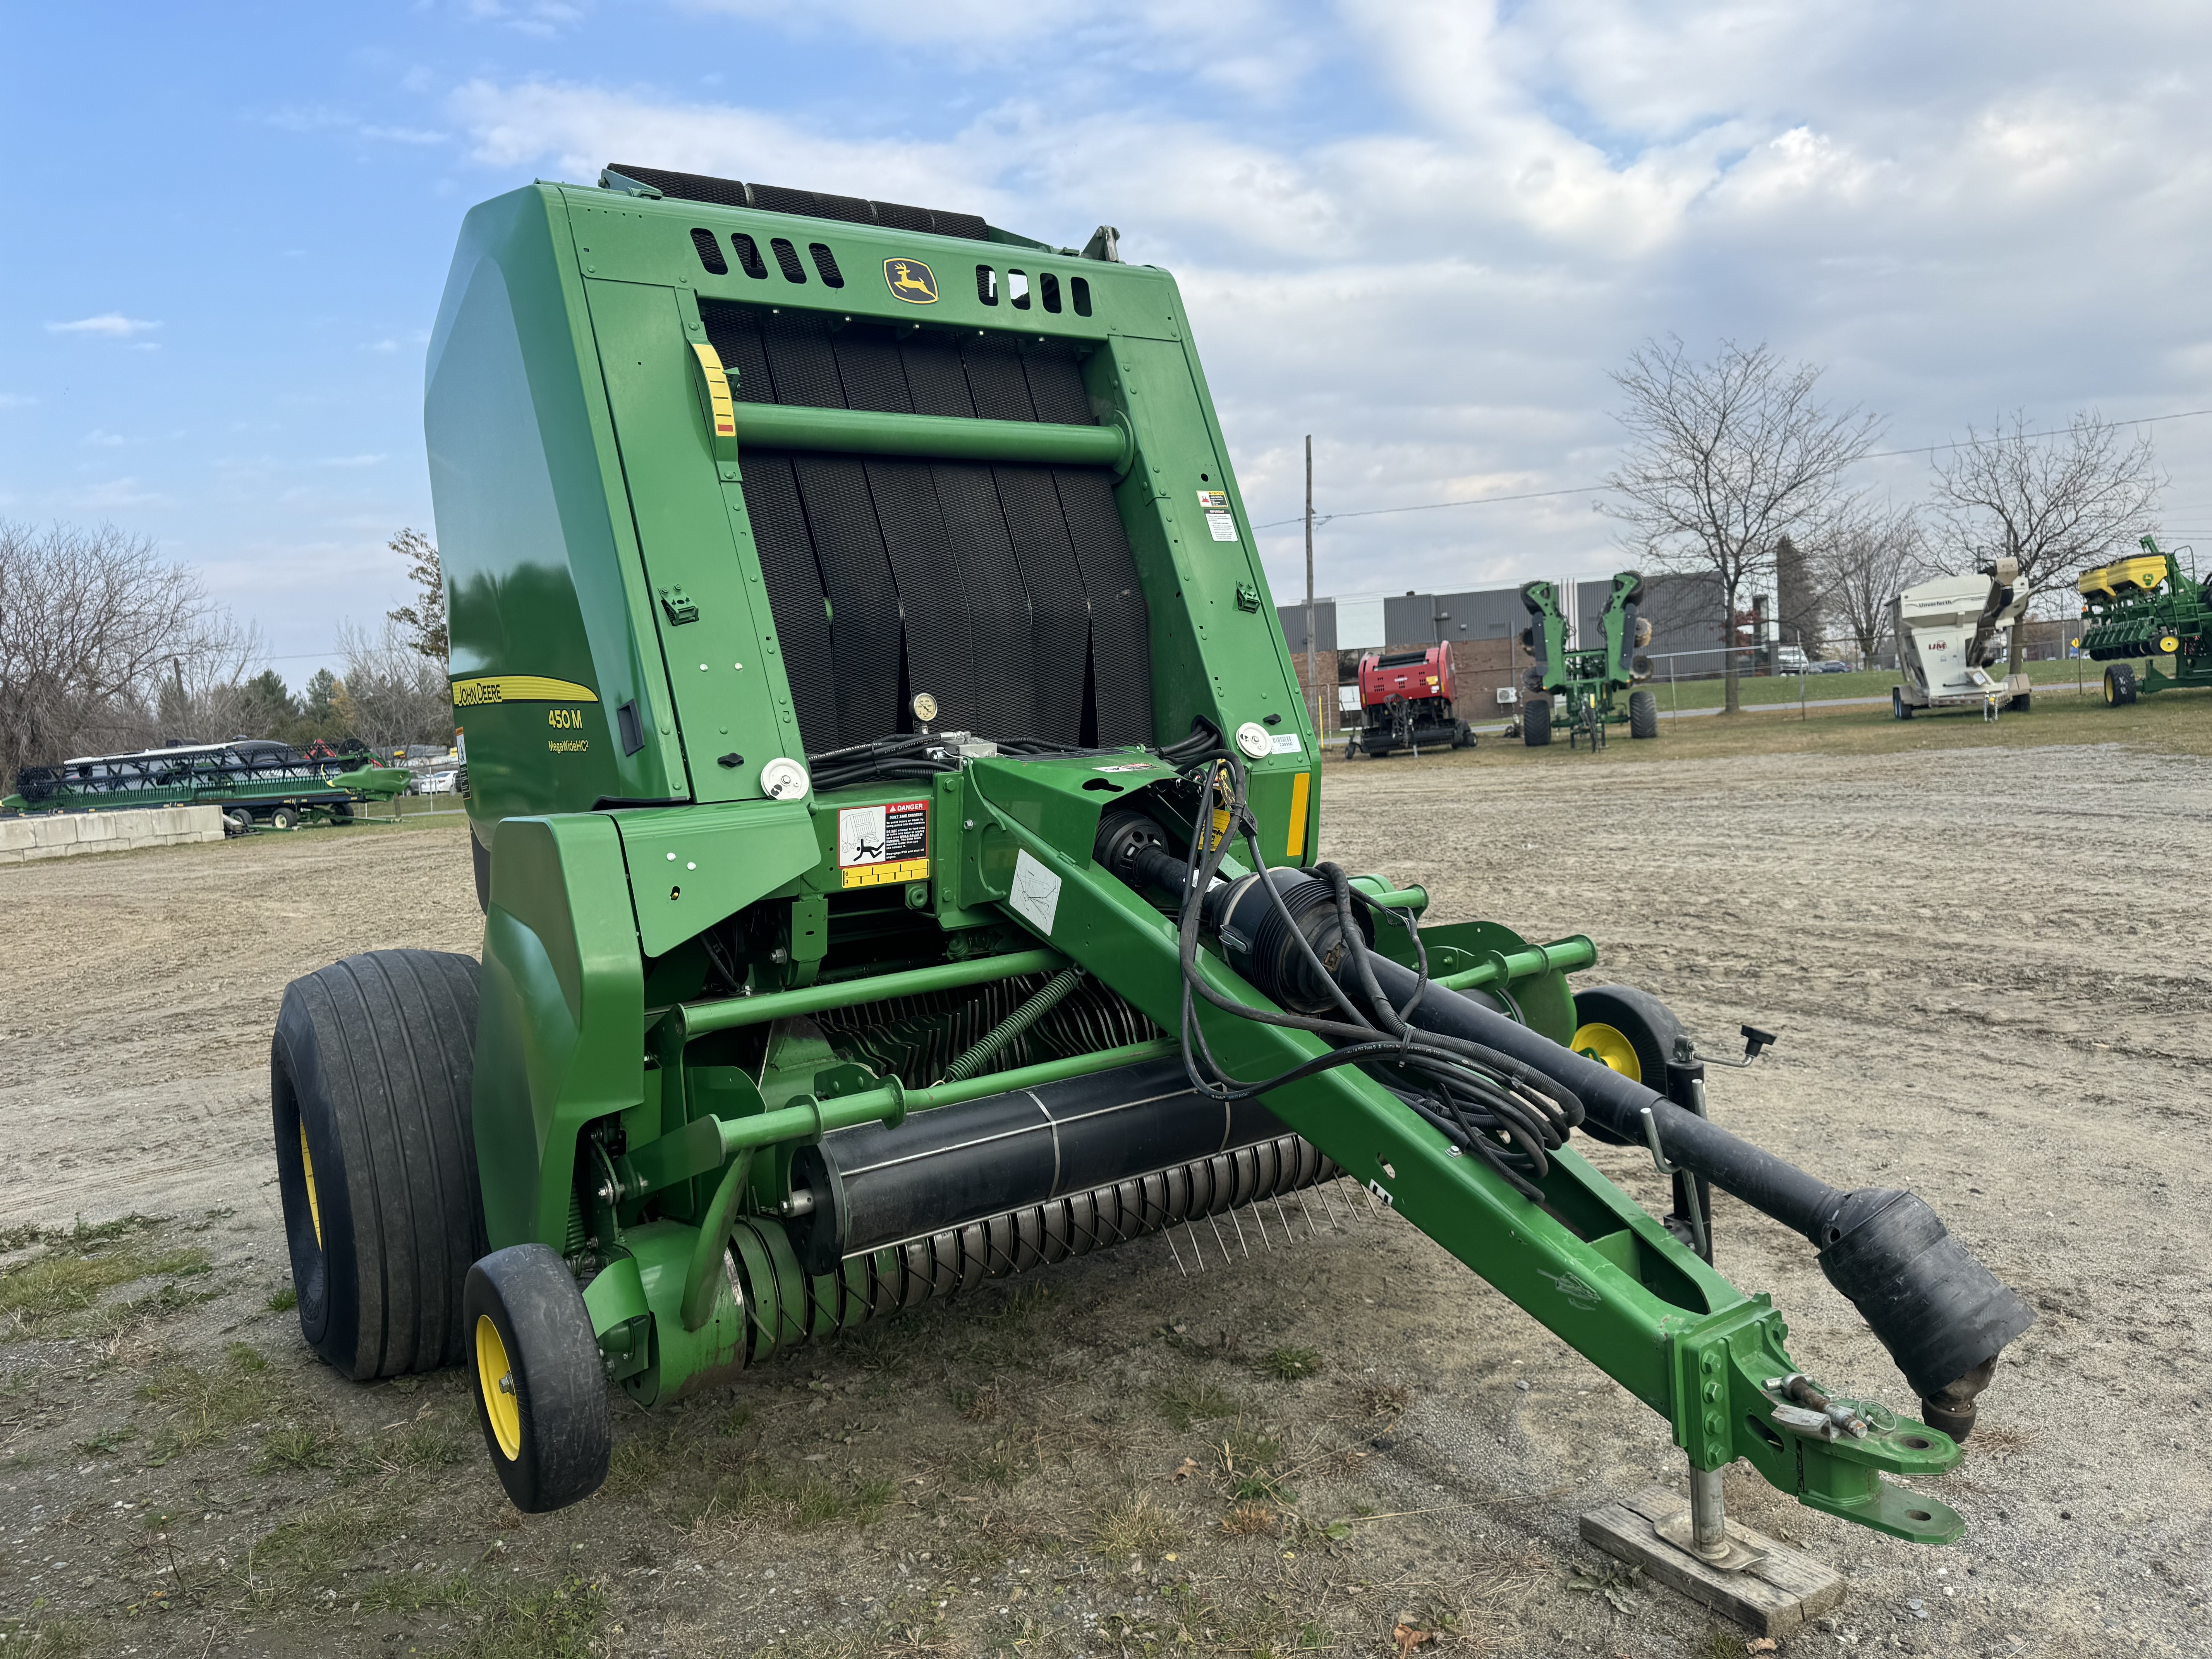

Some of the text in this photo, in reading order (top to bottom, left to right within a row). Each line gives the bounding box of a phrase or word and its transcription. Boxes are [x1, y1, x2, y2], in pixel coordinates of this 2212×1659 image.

[549, 710, 582, 728] 450 M
[897, 803, 923, 811] DANGER
